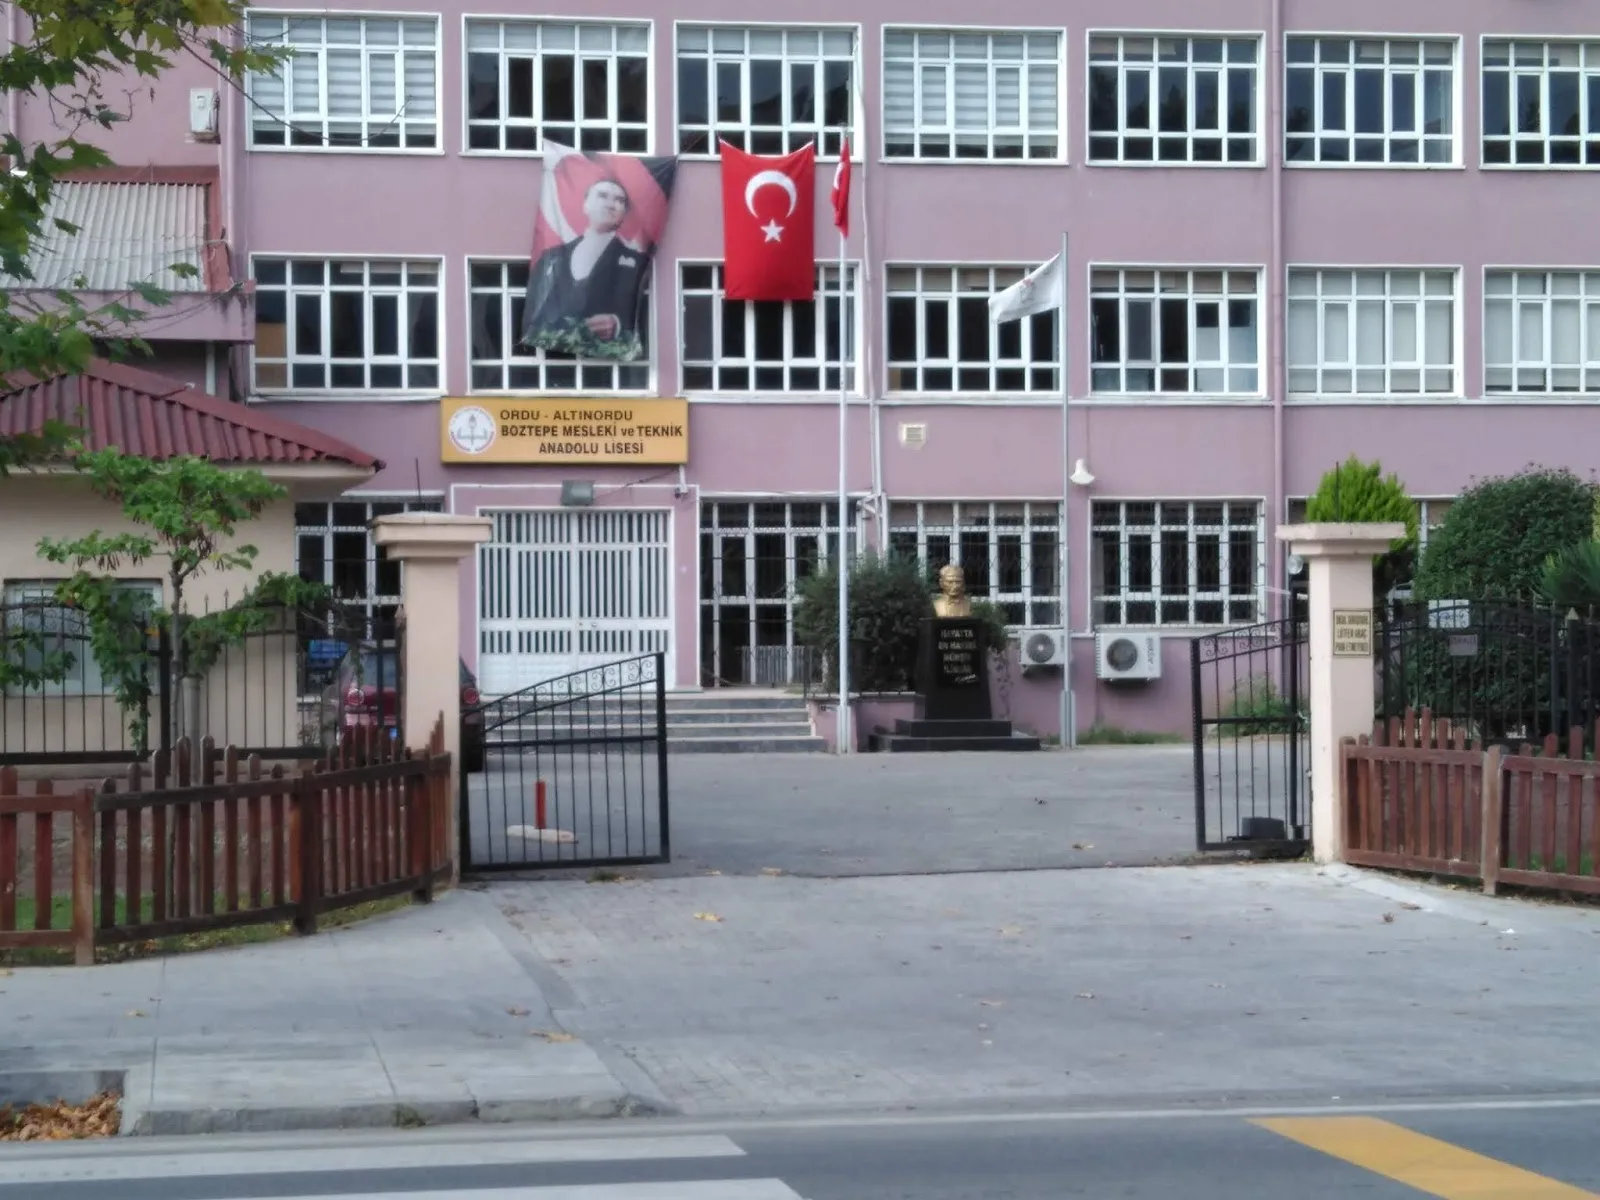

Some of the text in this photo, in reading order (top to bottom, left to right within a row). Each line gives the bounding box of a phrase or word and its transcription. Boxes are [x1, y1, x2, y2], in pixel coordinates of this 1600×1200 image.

[500, 409, 540, 421] ORDU
[553, 409, 633, 422] ALTINORDU
[501, 421, 683, 438] BOZTEPE MESLEKİ ve TEKNİK
[539, 438, 644, 455] ANADOLU LİSESİ
